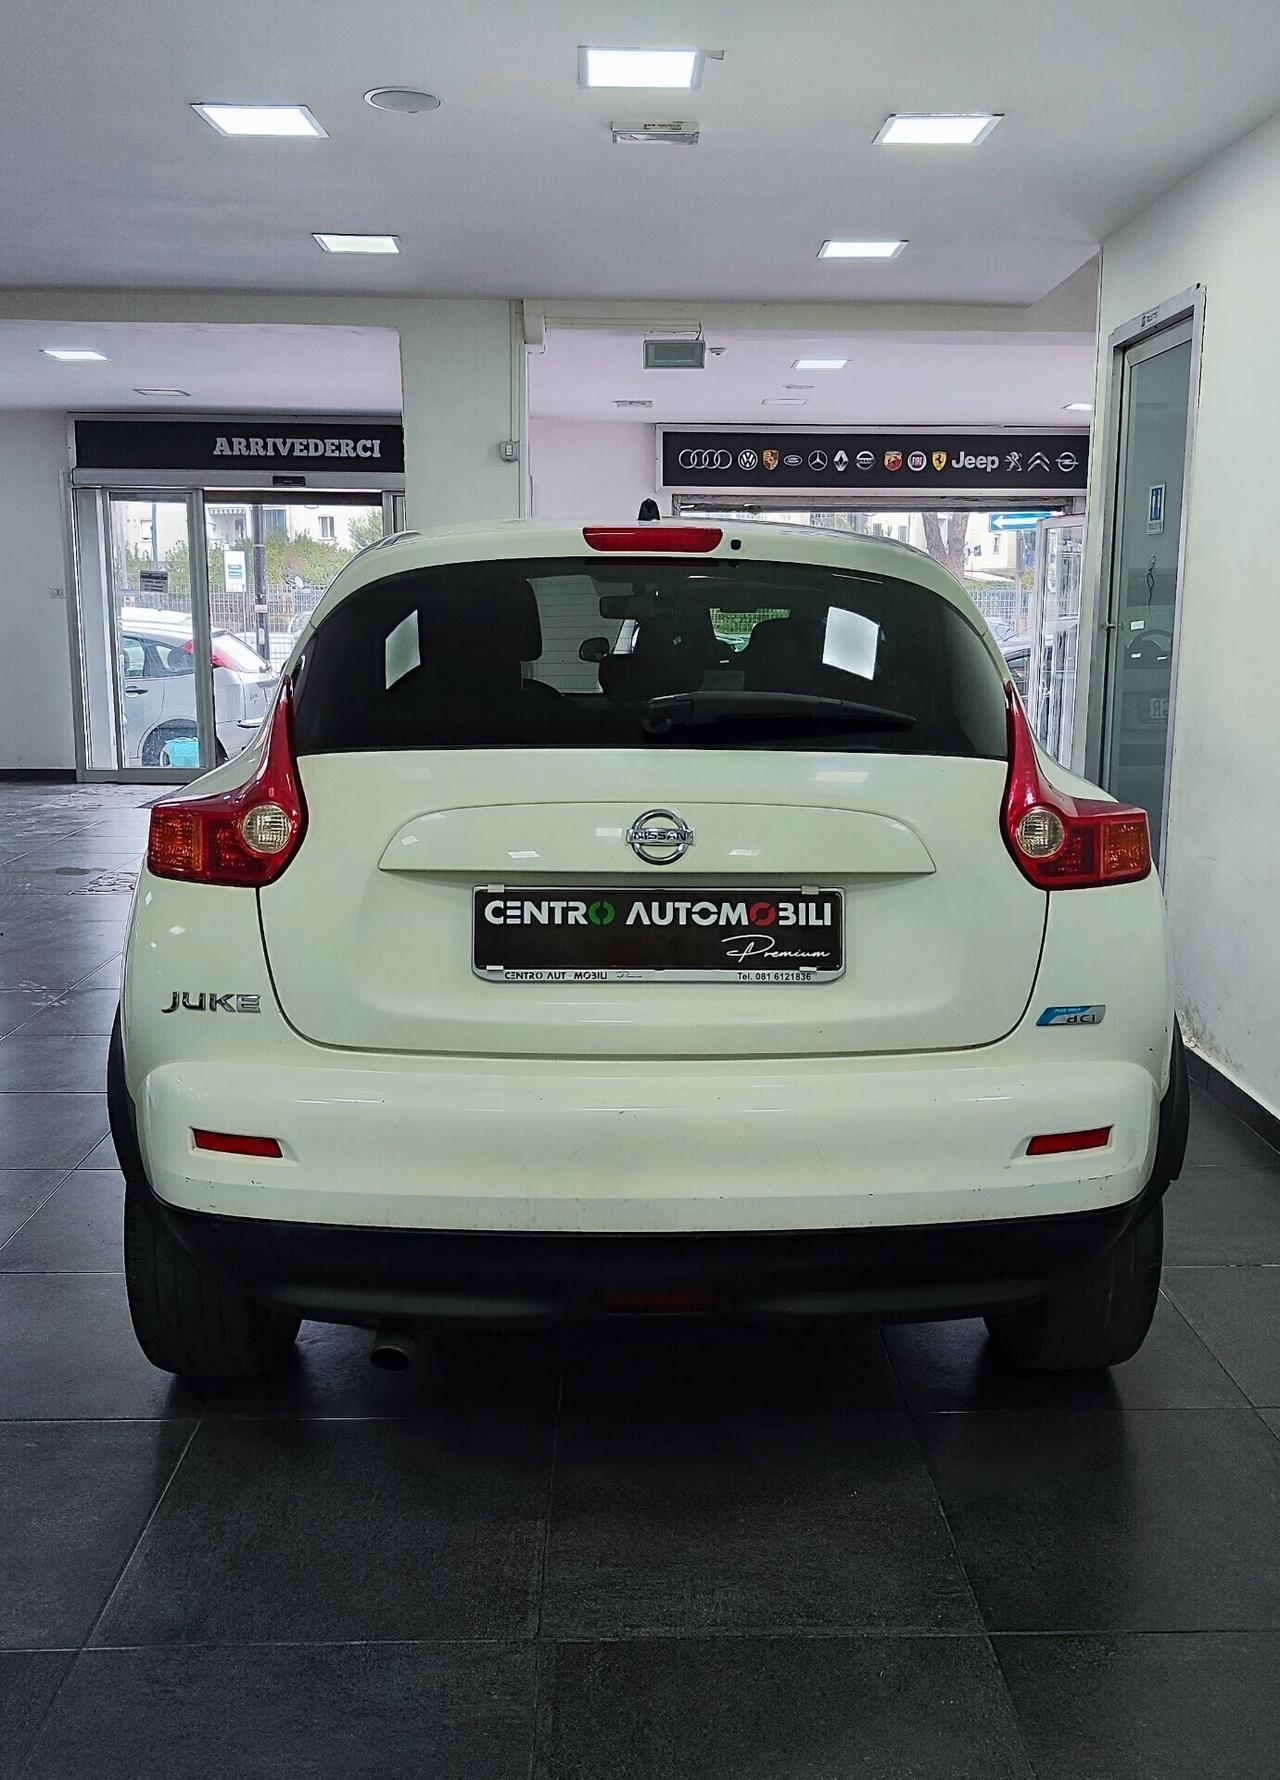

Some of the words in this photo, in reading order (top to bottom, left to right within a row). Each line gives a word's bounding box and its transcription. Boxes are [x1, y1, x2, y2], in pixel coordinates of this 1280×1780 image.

[213, 437, 382, 458] ARRIVEDERCI
[951, 451, 999, 472] Jeep
[633, 831, 687, 840] NISSAN
[484, 900, 615, 926] CENTRO
[625, 901, 832, 927] AUTOMOBILI
[721, 934, 831, 962] Premium
[504, 971, 543, 980] CENTRO
[737, 972, 753, 981] Tel.
[755, 972, 771, 981] 081
[774, 972, 812, 981] 6121836
[161, 991, 261, 1014] JUKE
